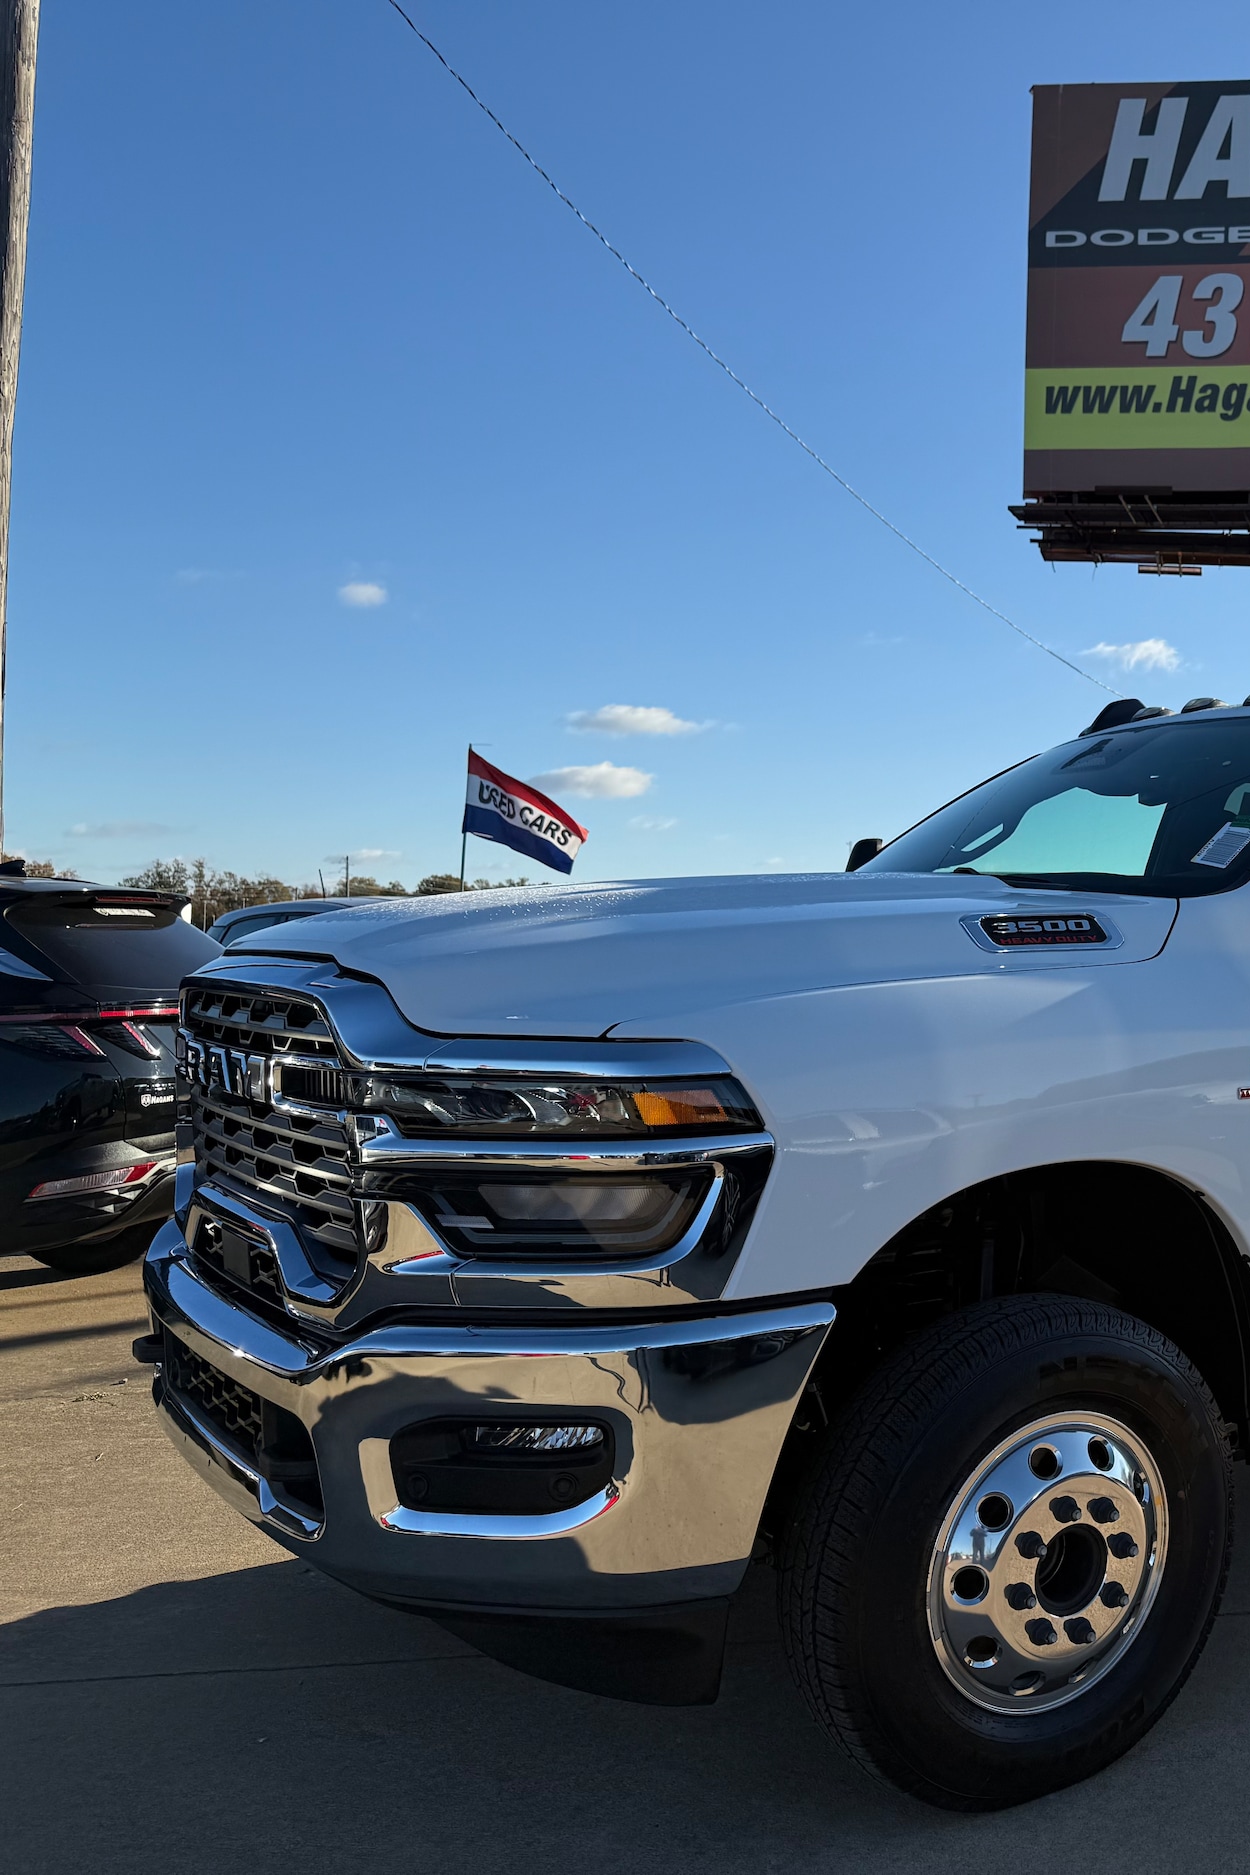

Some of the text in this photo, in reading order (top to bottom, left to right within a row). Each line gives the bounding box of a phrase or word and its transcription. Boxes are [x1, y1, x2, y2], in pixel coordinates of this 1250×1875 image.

[1120, 272, 1244, 358] 43
[478, 780, 574, 846] USED CARS
[992, 919, 1091, 934] 3500
[1000, 935, 1097, 945] HEAVY DUTY
